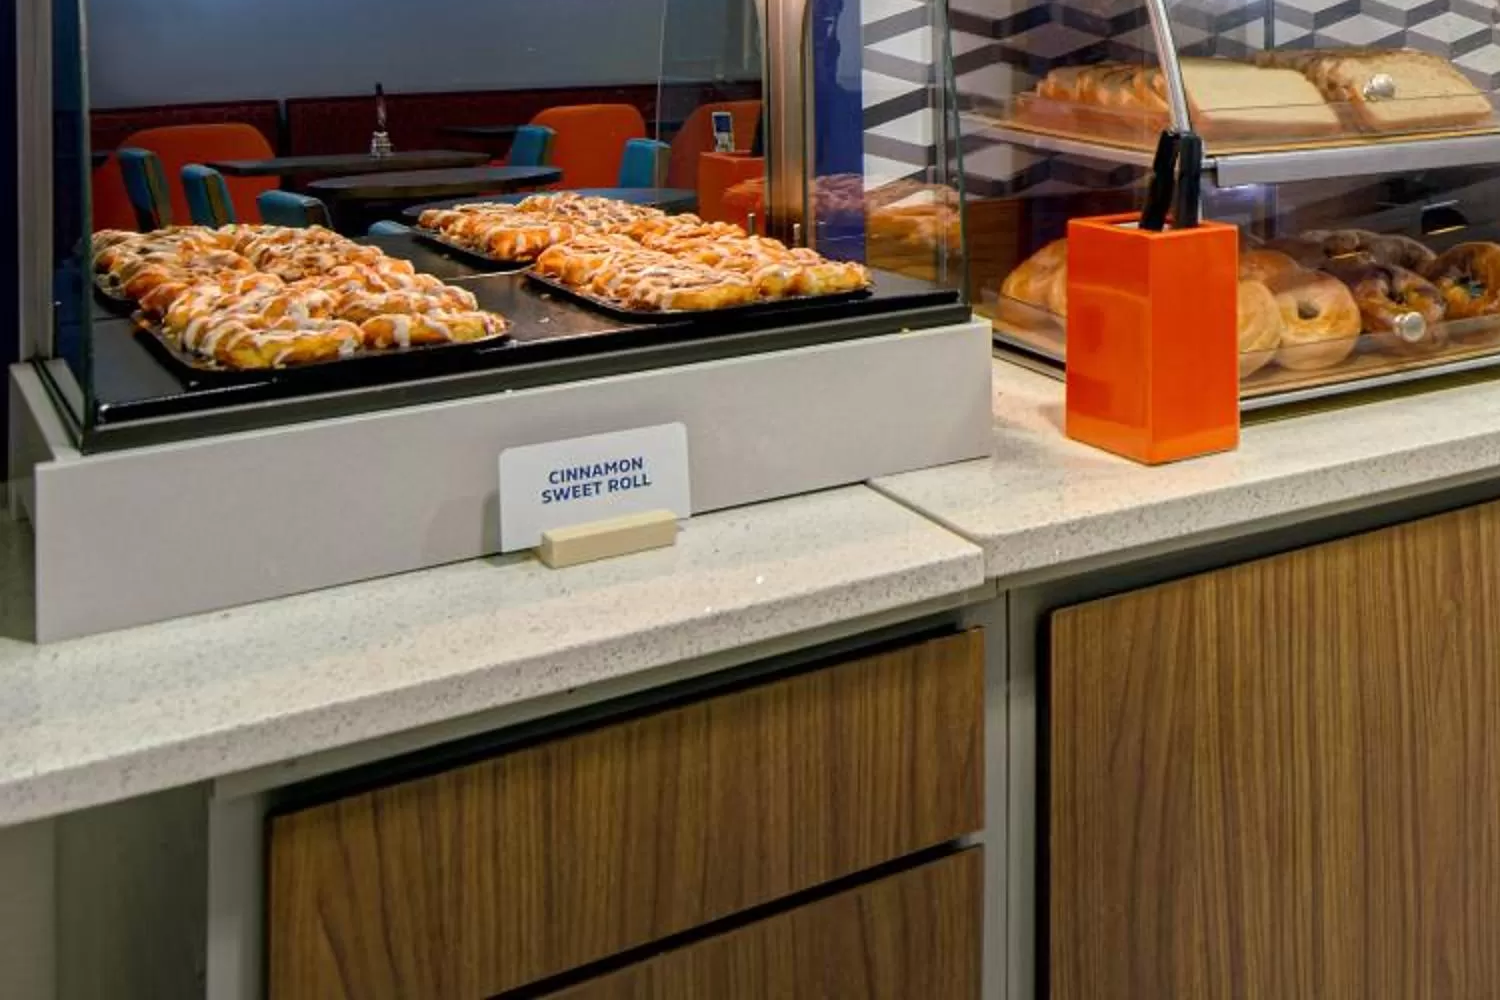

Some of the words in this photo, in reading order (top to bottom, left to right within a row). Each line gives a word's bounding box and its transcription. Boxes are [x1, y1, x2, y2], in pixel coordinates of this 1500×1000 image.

[549, 456, 643, 485] CINNAMON
[541, 481, 603, 504] SWEET
[608, 473, 653, 493] ROLL
